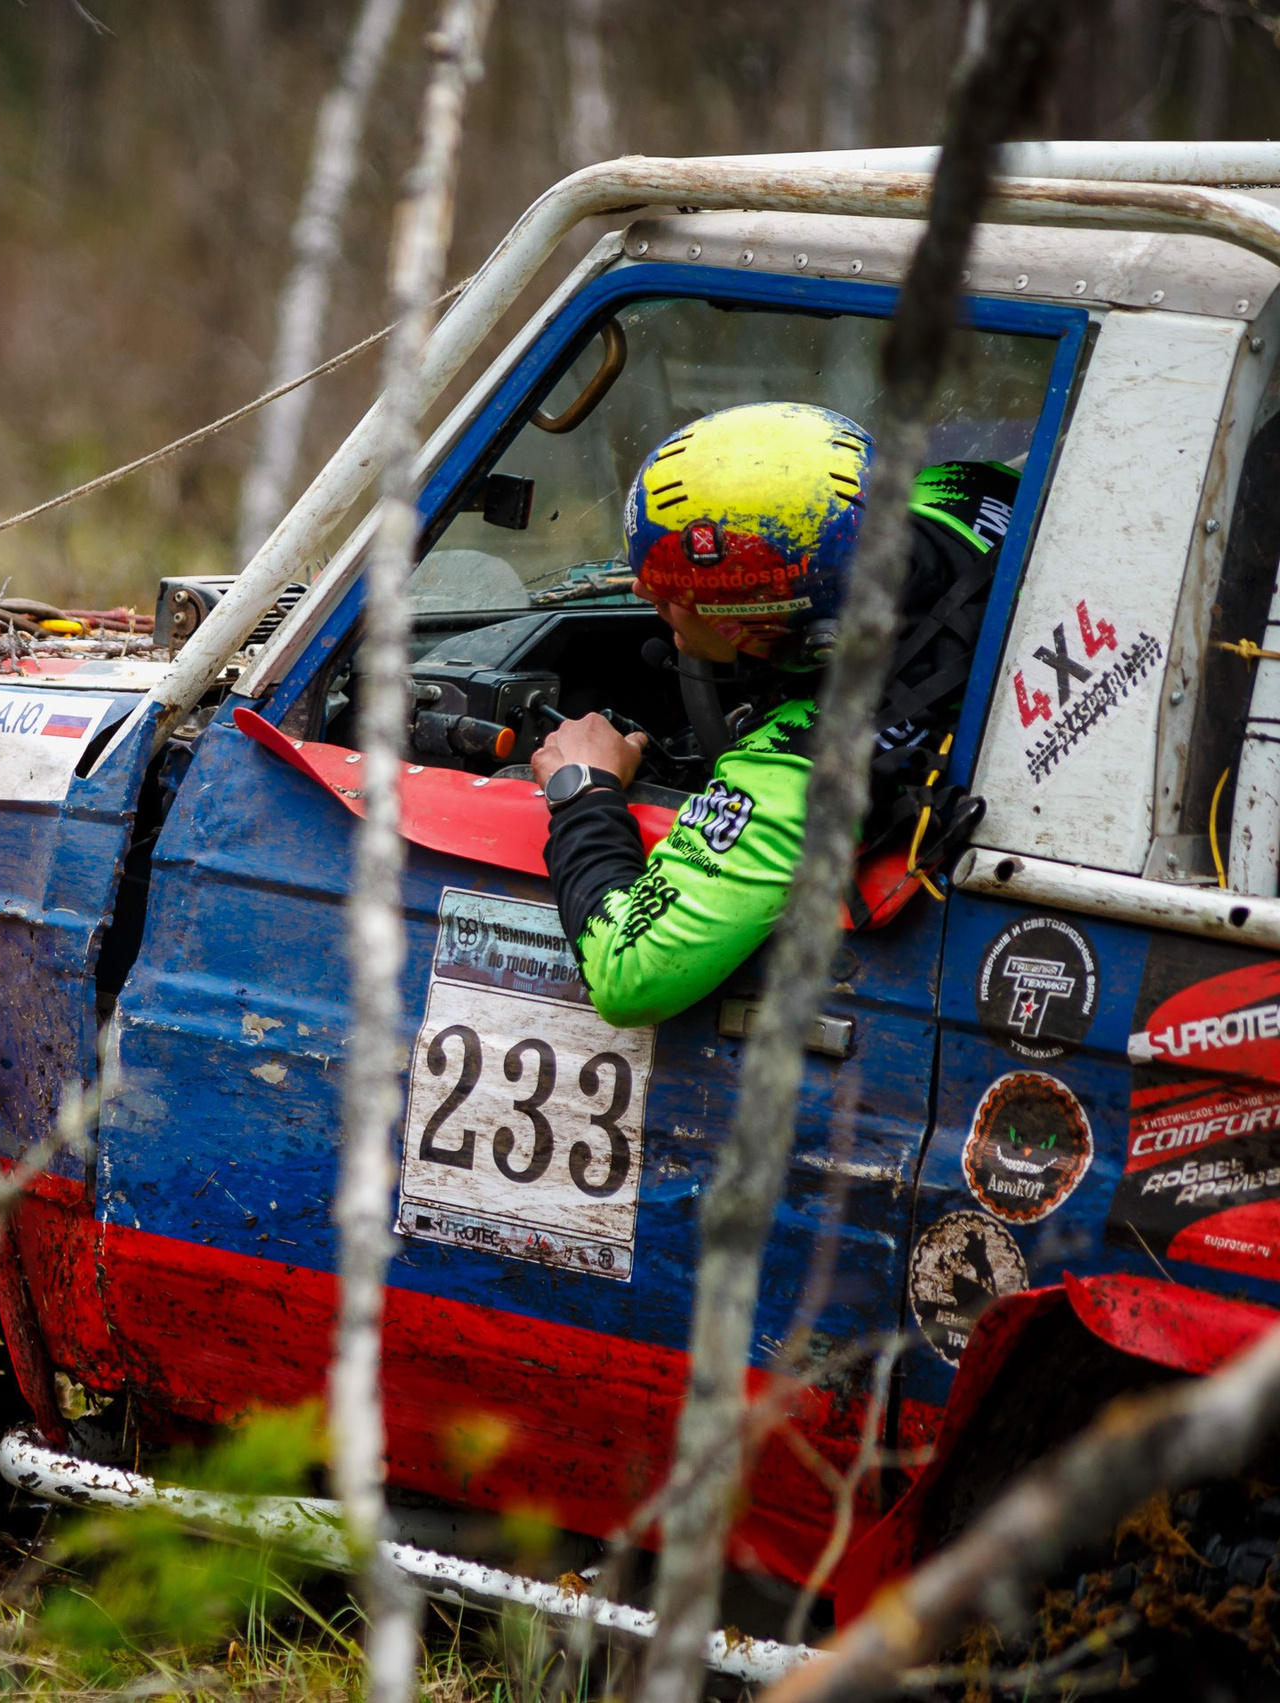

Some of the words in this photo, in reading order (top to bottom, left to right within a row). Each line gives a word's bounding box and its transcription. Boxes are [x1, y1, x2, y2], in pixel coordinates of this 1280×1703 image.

[702, 601, 807, 614] BLOKIROVKA.RU
[493, 923, 568, 951] Чемпионат
[488, 952, 504, 968] по
[506, 954, 580, 983] трофи-рей
[981, 932, 1011, 1001] ЛАЗЕРНЫЕ
[1012, 925, 1021, 937] И
[1023, 918, 1094, 973] СВЕТОДИОДНЫЕ
[1132, 1004, 1280, 1061] SUPROTE
[419, 1024, 634, 1198] 233
[1204, 1233, 1271, 1258] suprotec.ru
